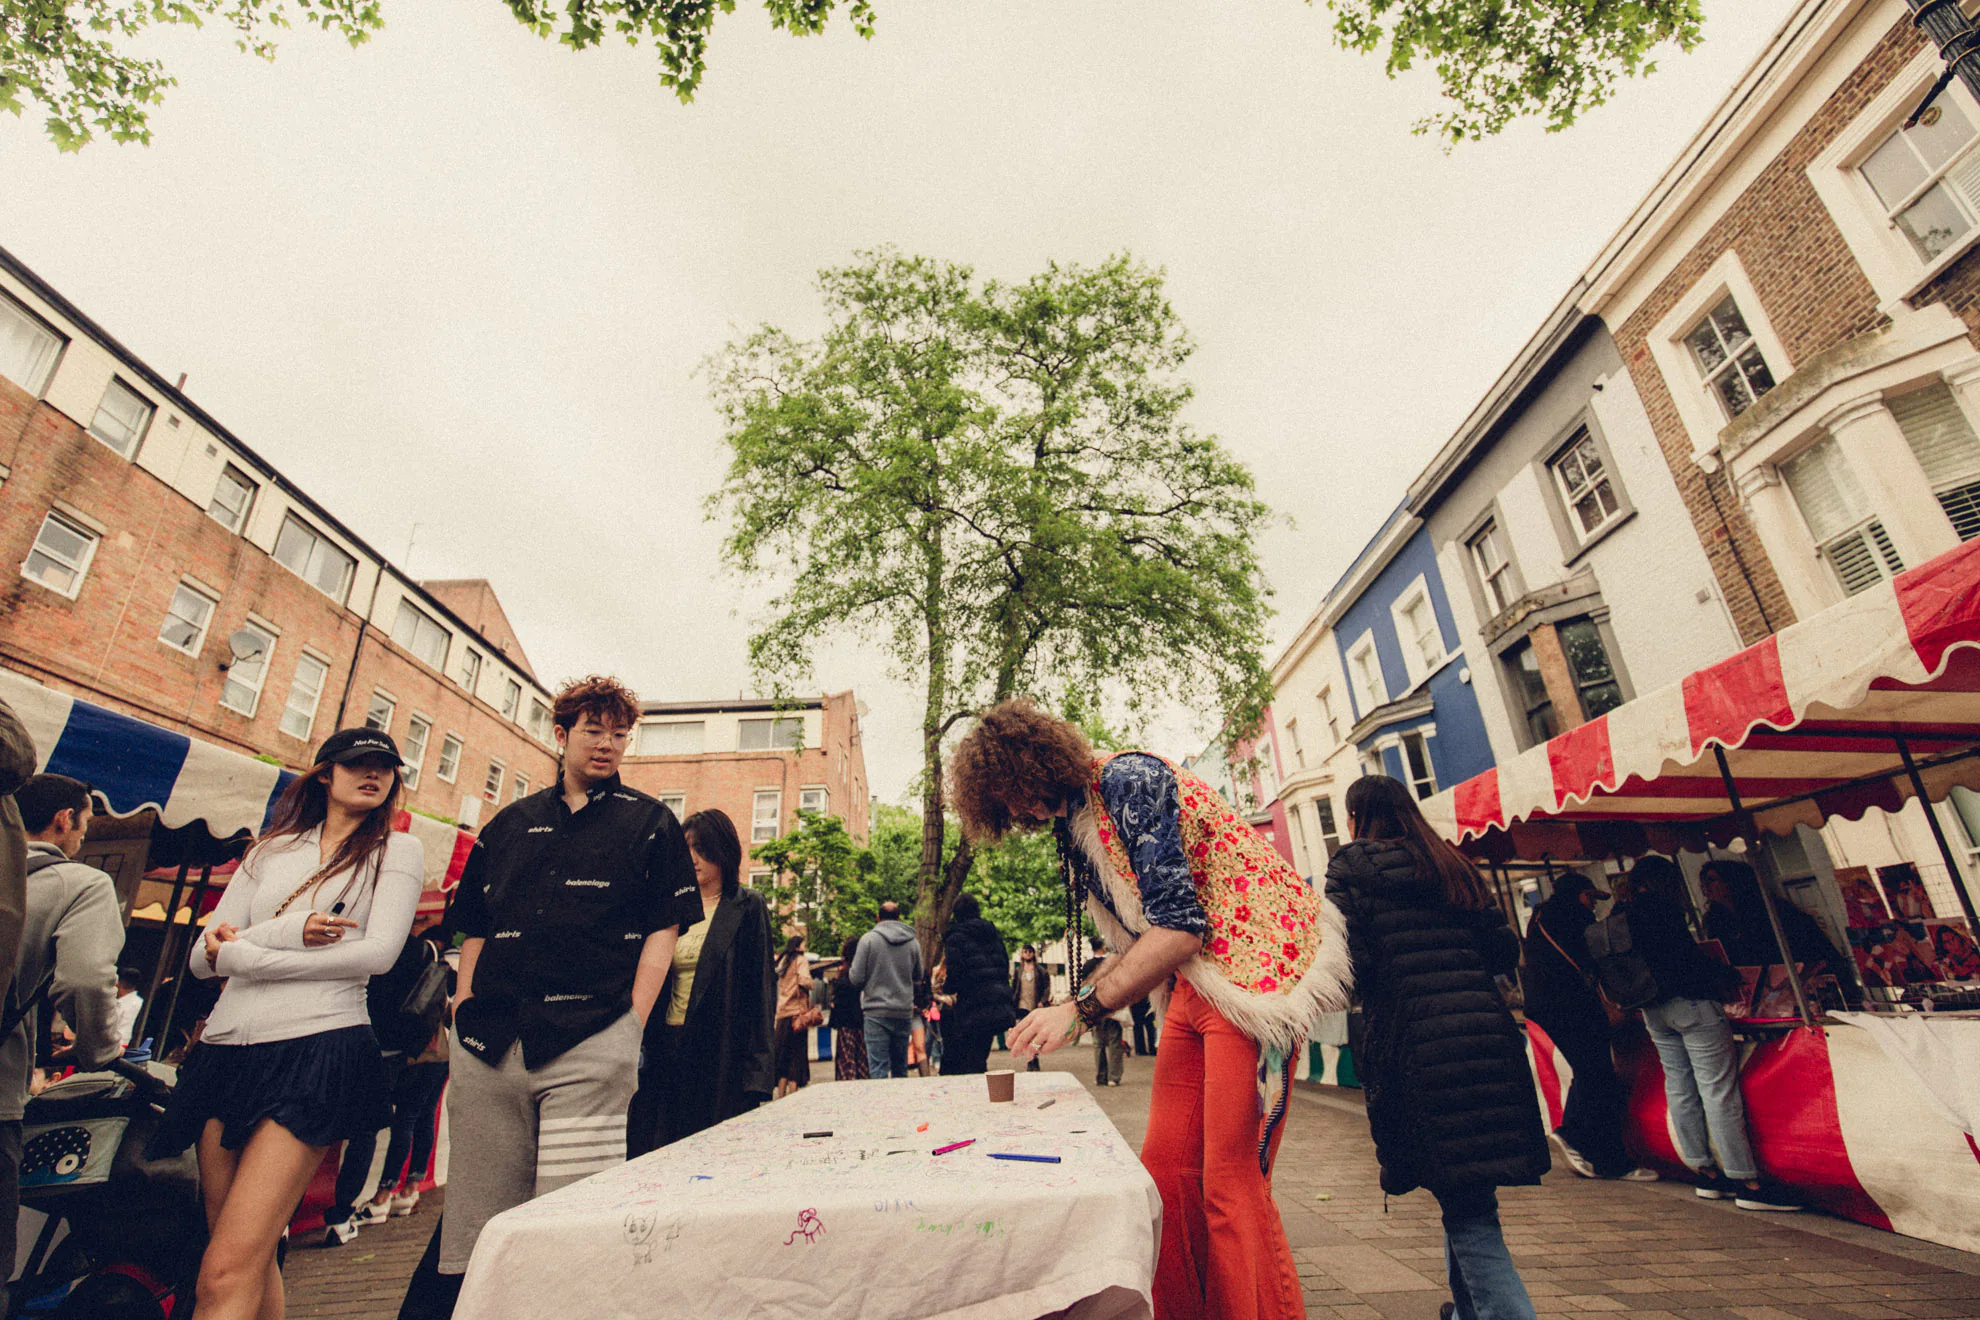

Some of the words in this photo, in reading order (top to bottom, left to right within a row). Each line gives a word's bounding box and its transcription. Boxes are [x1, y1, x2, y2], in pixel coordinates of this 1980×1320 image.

[565, 879, 611, 889] balenciaga
[494, 930, 522, 939] shirts
[463, 1036, 486, 1051] shirts
